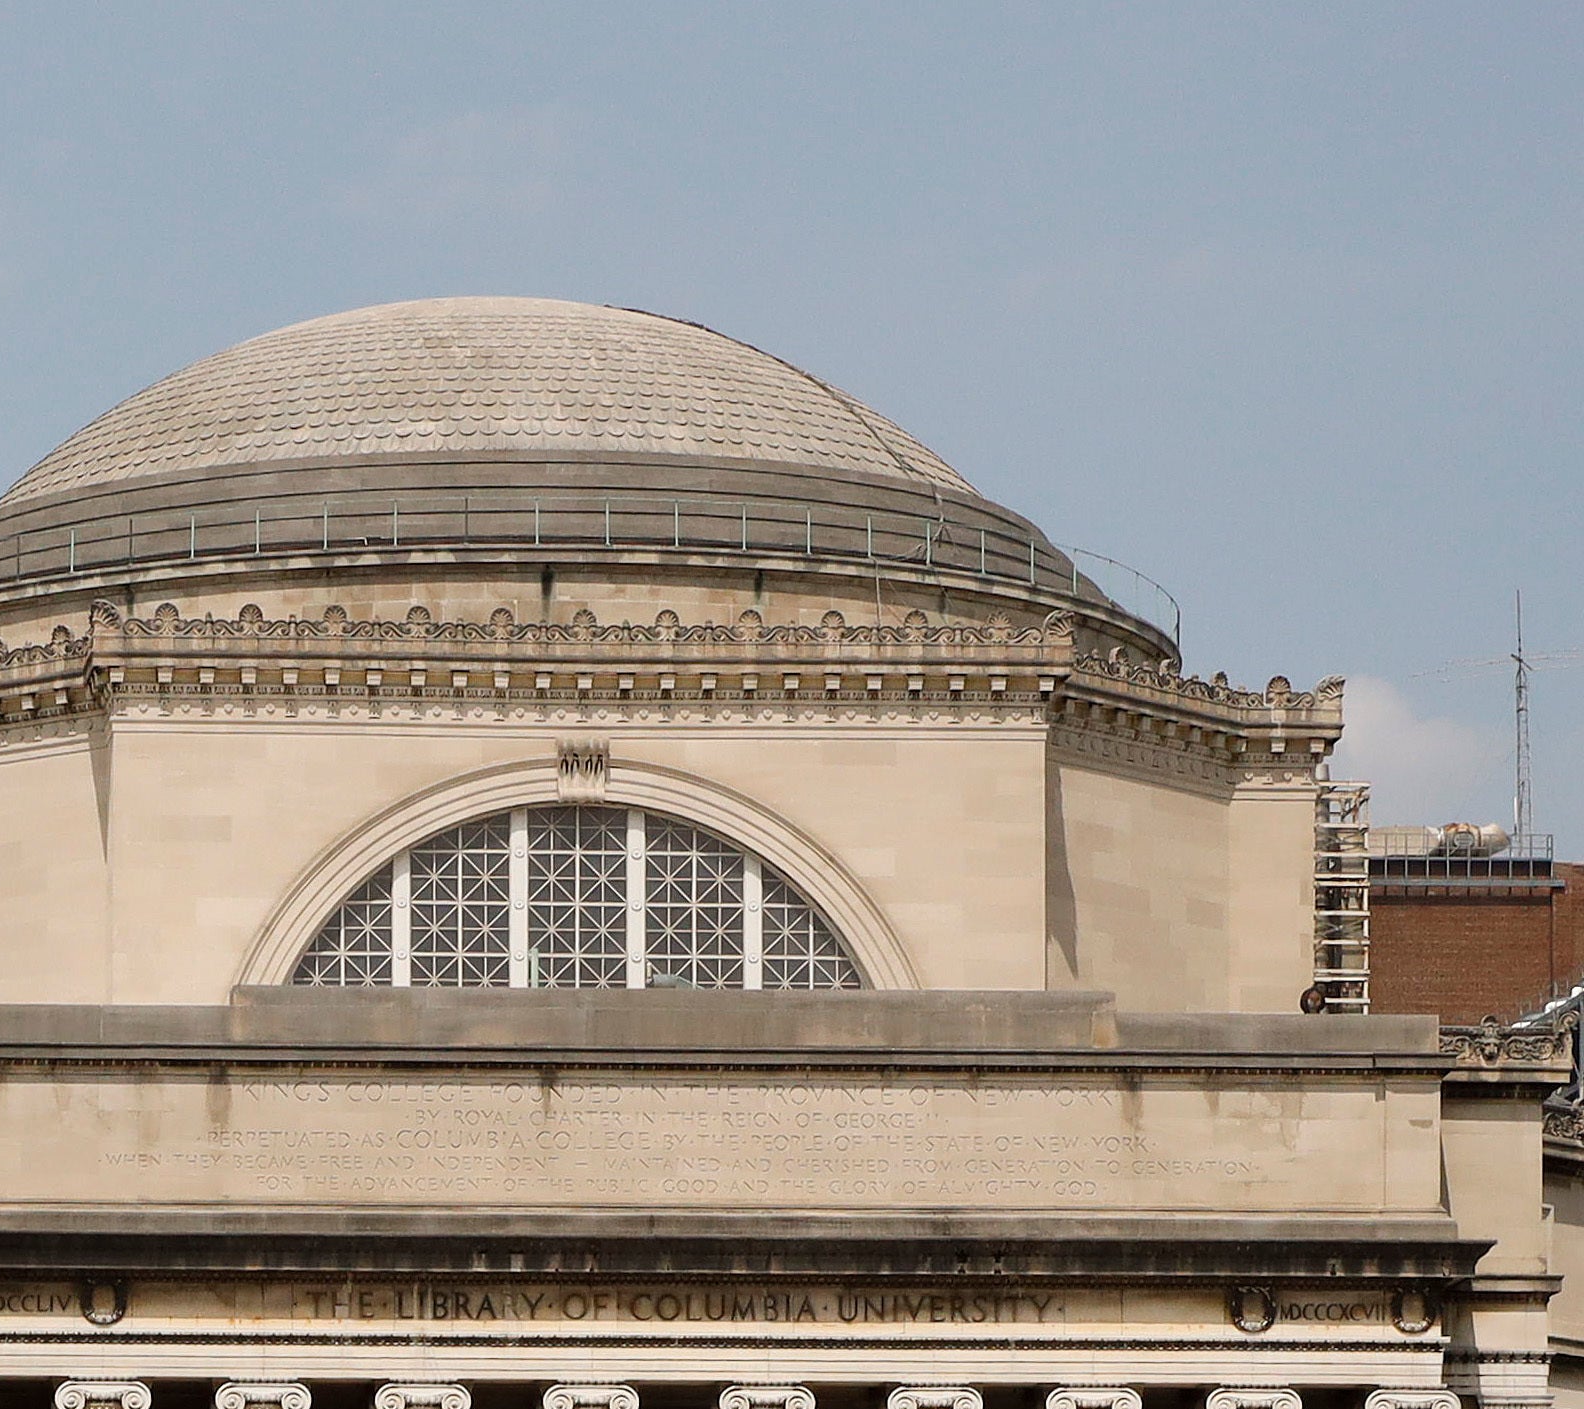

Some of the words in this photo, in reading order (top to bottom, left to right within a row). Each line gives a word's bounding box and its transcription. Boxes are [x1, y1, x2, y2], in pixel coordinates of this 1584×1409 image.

[306, 1291, 375, 1319] THE
[396, 1292, 545, 1320] LIBRARY
[562, 1293, 609, 1320] OF
[631, 1294, 817, 1321] COLUMBIA
[838, 1295, 1051, 1323] UNIVERSITY
